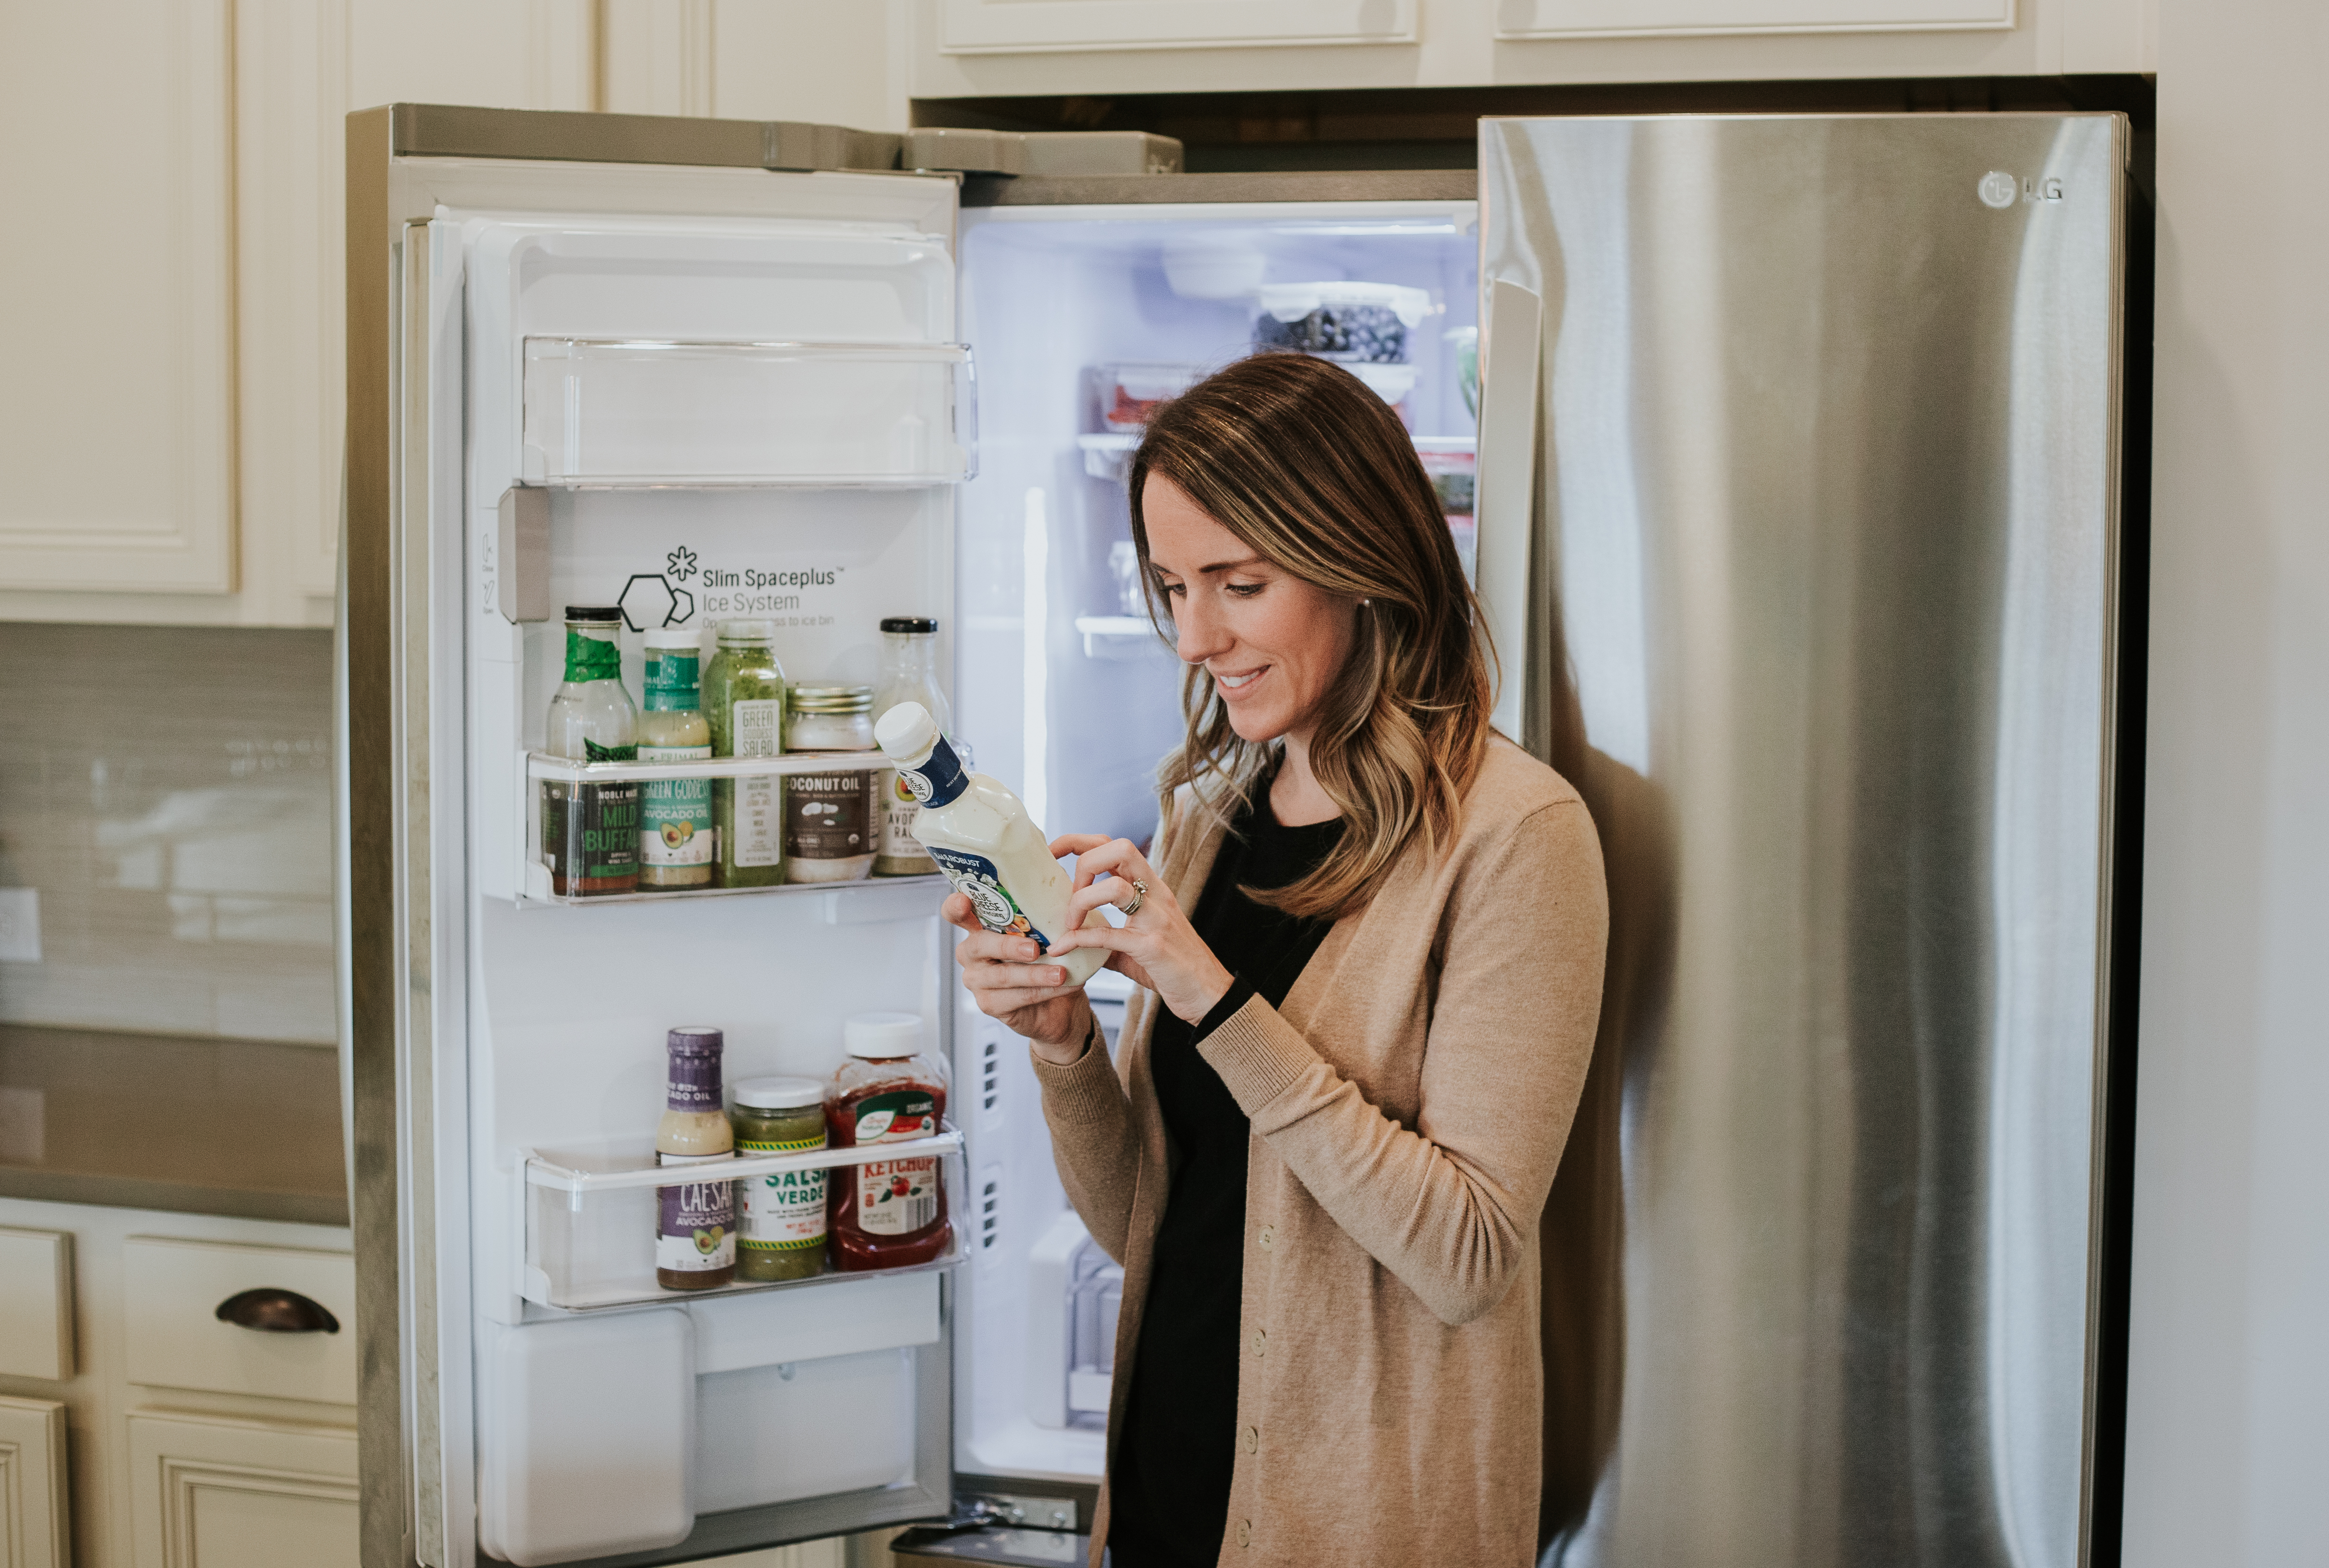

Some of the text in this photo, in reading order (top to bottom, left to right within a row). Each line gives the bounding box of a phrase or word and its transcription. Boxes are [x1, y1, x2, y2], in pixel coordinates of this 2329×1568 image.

[2022, 176, 2063, 204] LG
[703, 570, 740, 588] Slim
[703, 593, 800, 614] Ice System
[789, 616, 799, 626] to
[801, 616, 816, 626] ice
[818, 615, 835, 625] bin
[743, 711, 773, 727] GREEN
[743, 739, 773, 757] SALAD
[841, 776, 860, 791] OIL
[598, 790, 624, 800] NOBLE
[603, 805, 636, 827] MILD
[644, 809, 694, 820] AVOCADO
[950, 855, 980, 867] ROBUST
[969, 891, 991, 902] BLUE
[971, 898, 1003, 912] CHEESE
[693, 1092, 710, 1101] OIL
